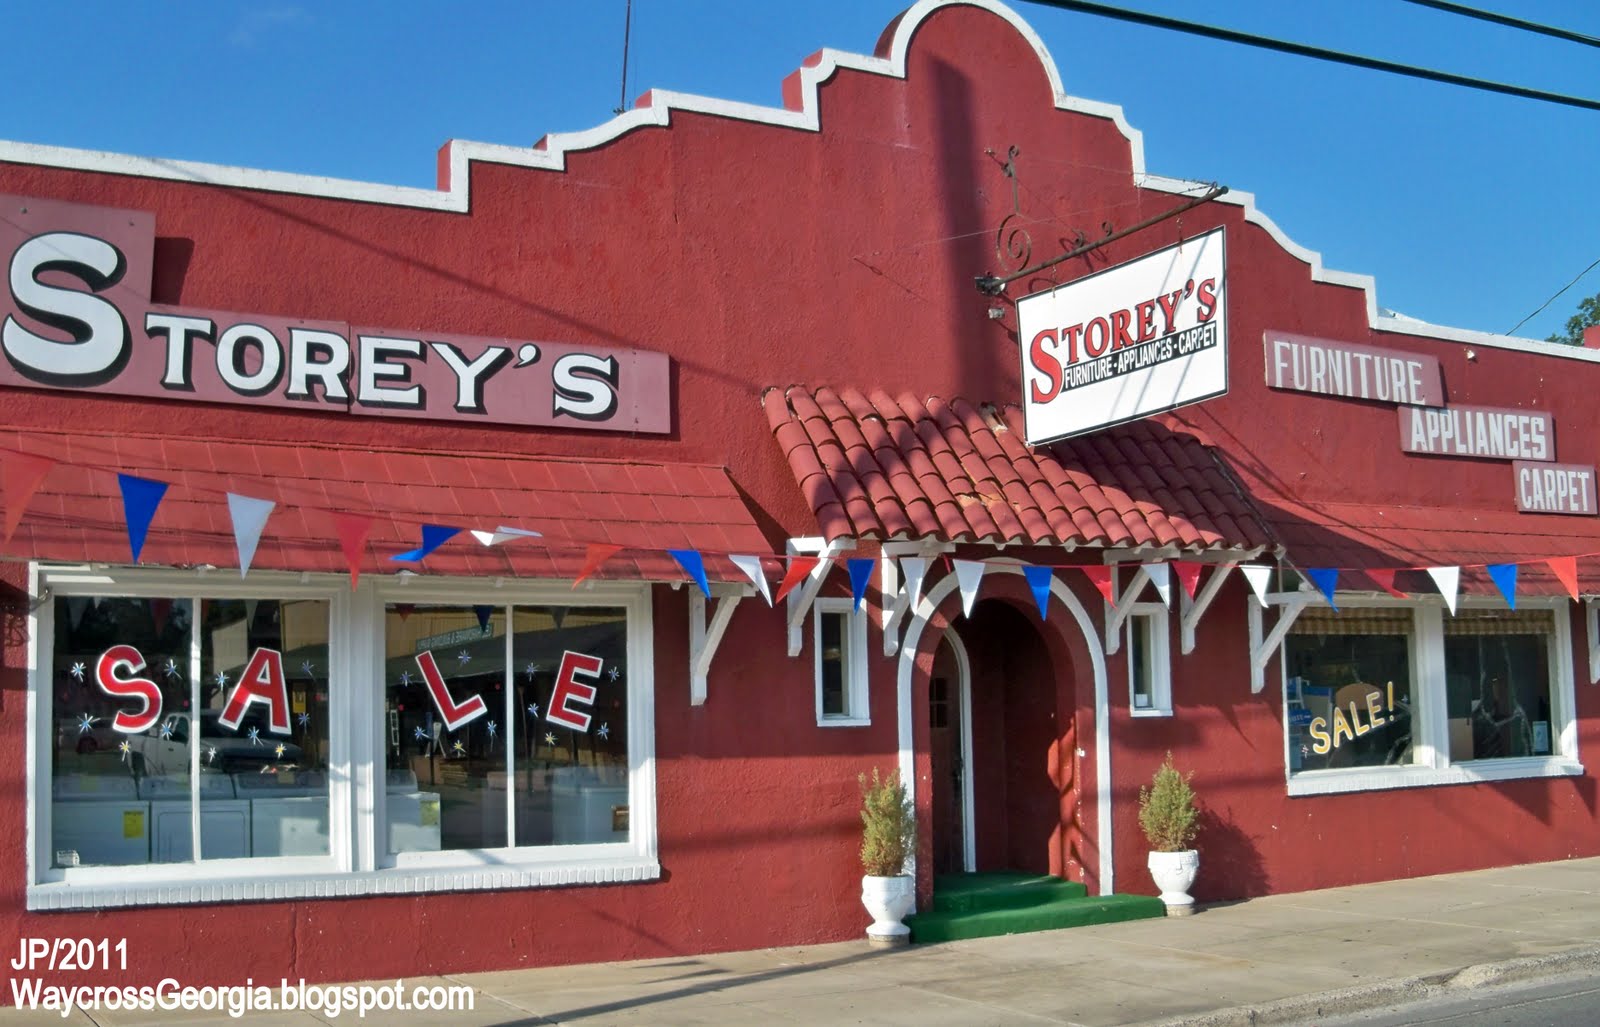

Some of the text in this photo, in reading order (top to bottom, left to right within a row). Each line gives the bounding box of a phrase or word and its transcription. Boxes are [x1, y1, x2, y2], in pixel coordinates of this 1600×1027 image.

[1, 231, 618, 419] STOREY'S
[1030, 277, 1217, 404] STOREY'S
[1064, 323, 1216, 389] FURNITURE APPLIANCES CARPET
[1273, 341, 1426, 405] FURNITURE
[1411, 407, 1547, 459] APPLIANCES
[1520, 468, 1589, 511] CARPET
[1309, 681, 1394, 755] SALE!
